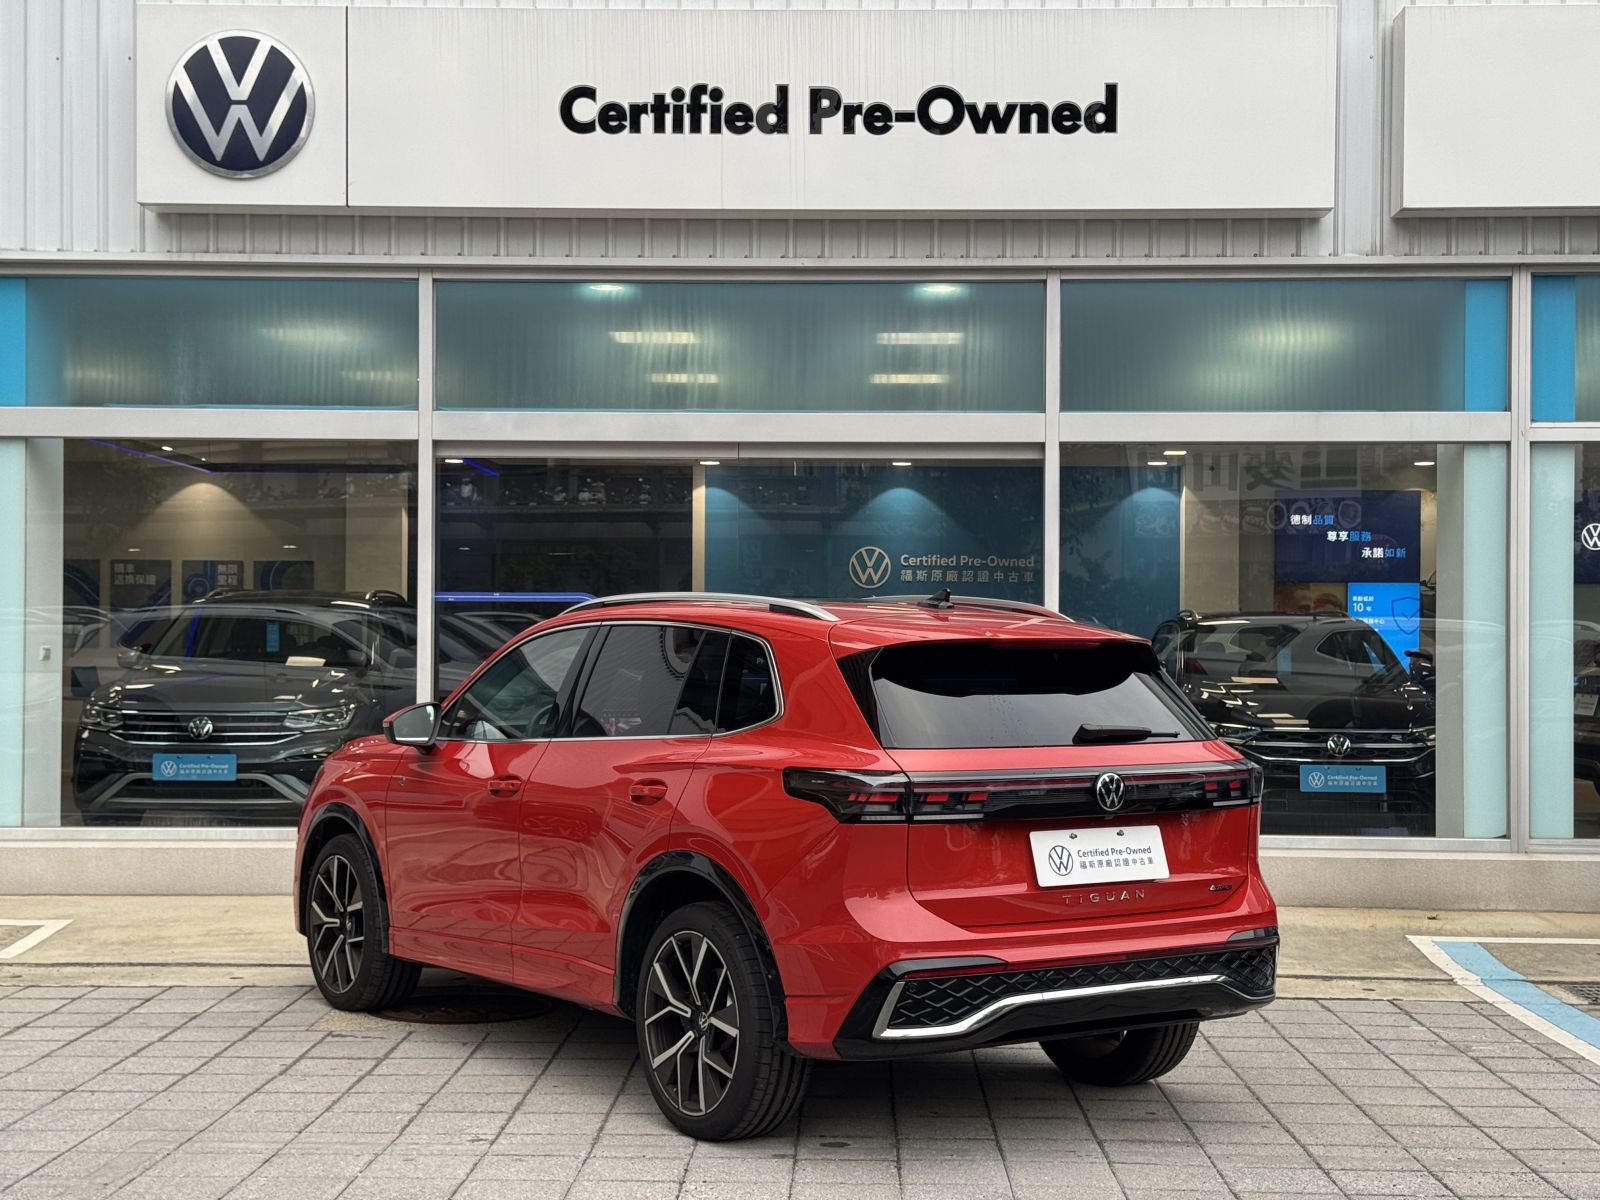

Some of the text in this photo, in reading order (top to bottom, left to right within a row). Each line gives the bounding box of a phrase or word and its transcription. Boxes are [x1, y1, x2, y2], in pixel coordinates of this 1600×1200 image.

[559, 82, 1119, 135] Certified Pre-Owned
[1326, 531, 1372, 542] 尊享服務
[1361, 547, 1406, 558] 承諾如新
[900, 554, 1035, 567] Certified Pre-Owned
[900, 569, 1035, 583] 福斯原廠認證中古車
[1353, 603, 1364, 612] 10
[1077, 845, 1152, 858] Certified Pre-Owned
